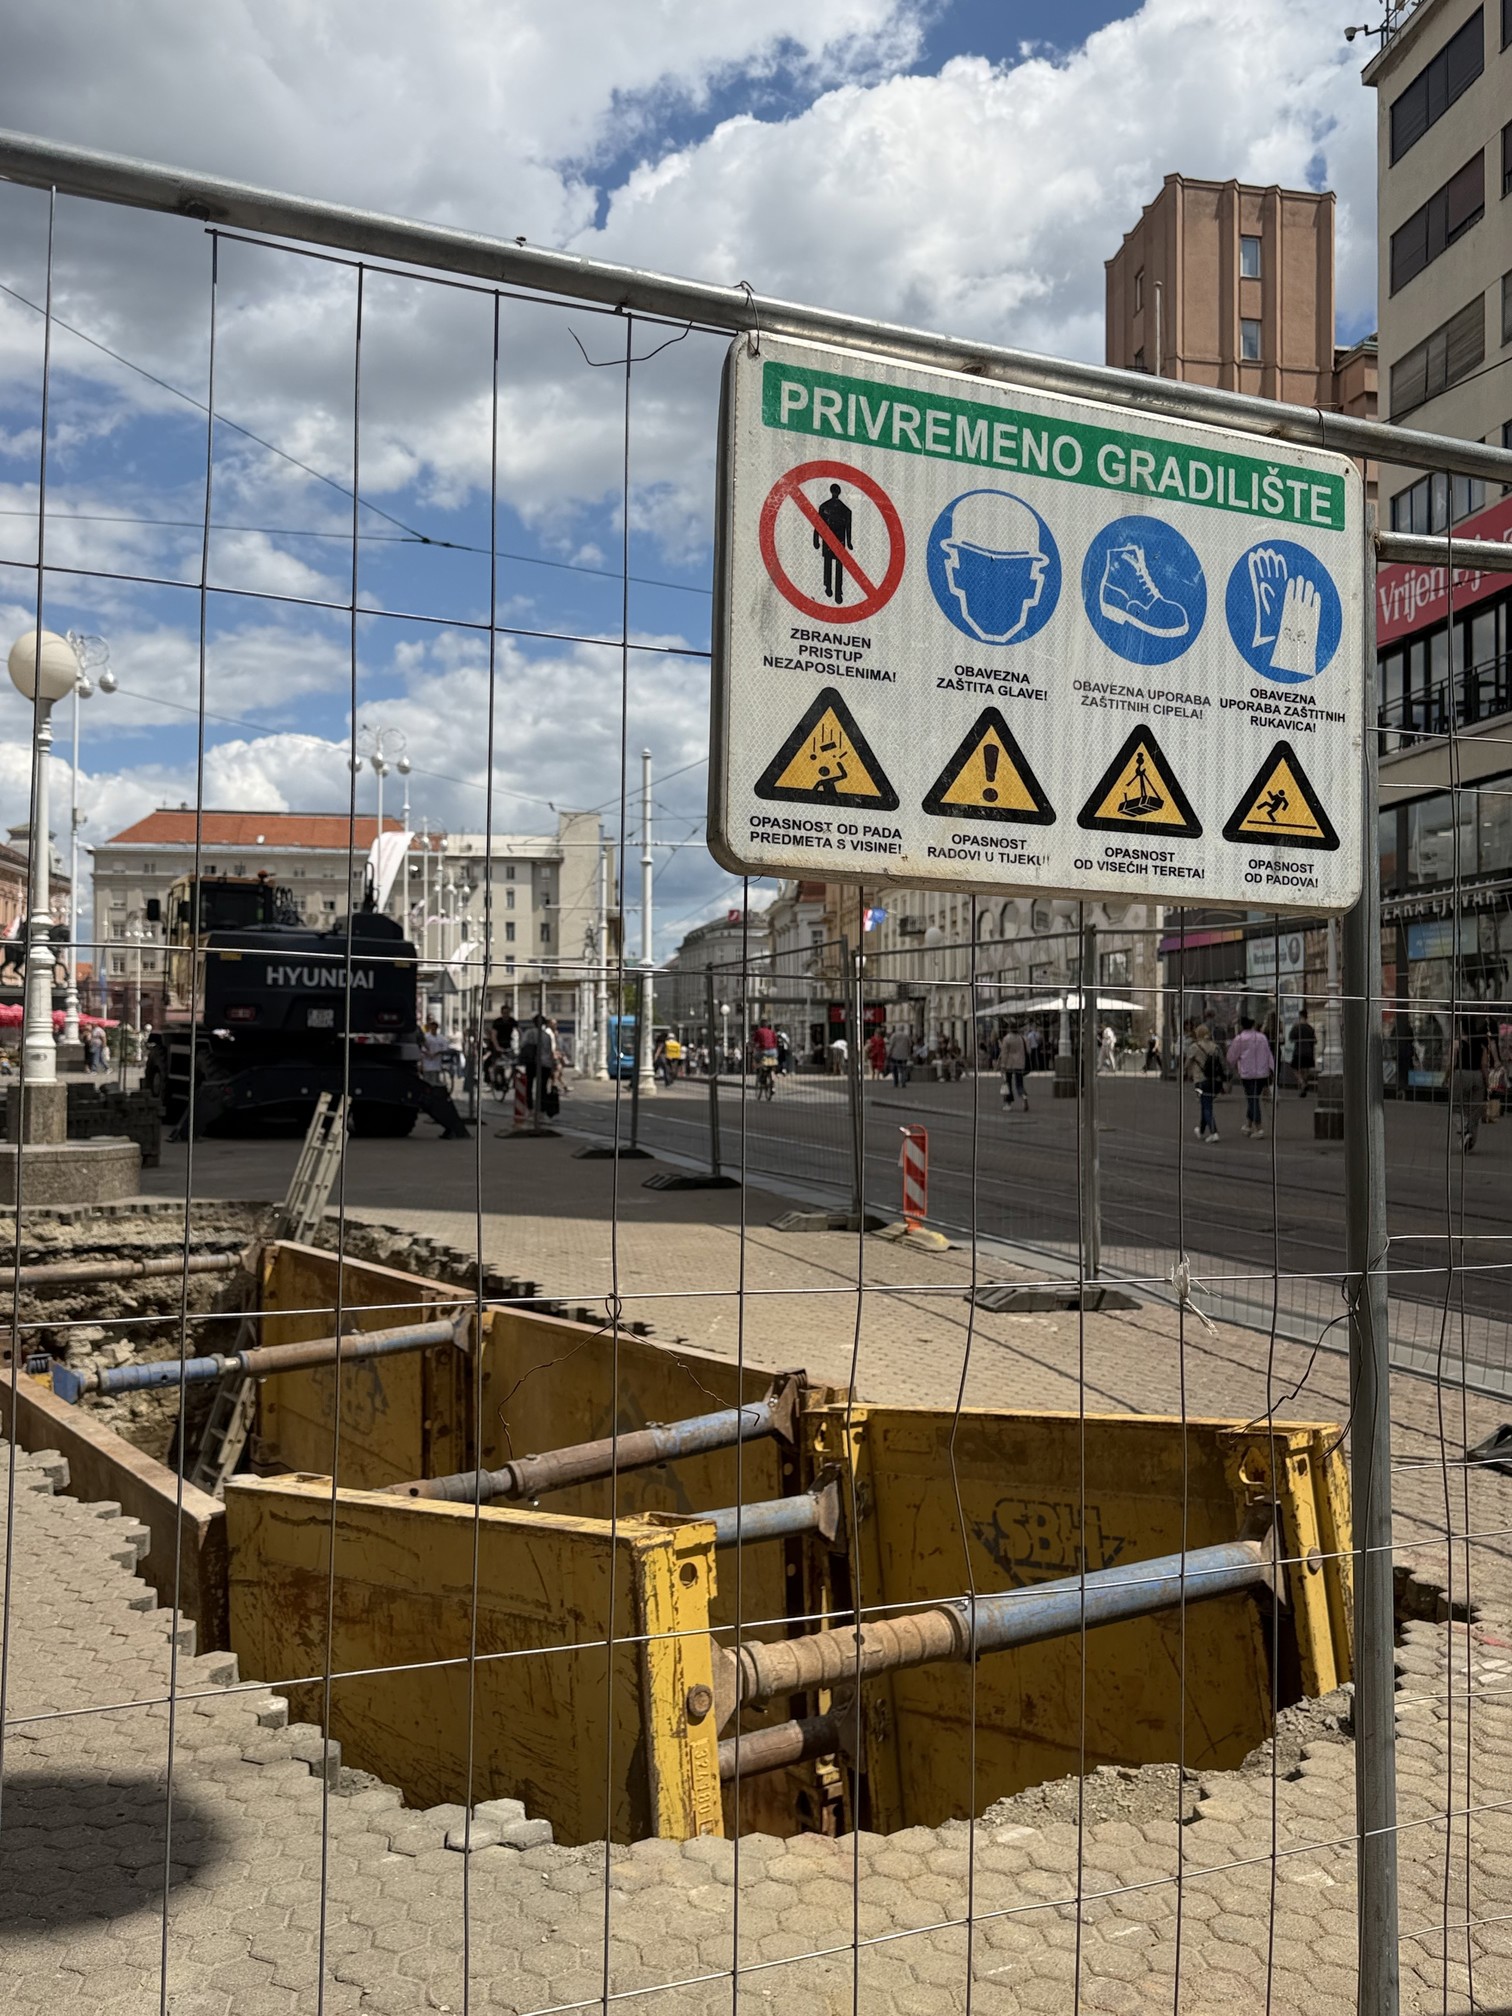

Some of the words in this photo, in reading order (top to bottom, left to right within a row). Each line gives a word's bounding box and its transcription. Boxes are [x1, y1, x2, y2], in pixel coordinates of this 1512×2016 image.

[779, 381, 1083, 477] PRIVREMENO
[1097, 443, 1332, 525] GRADILIŠTE
[790, 627, 871, 649] ZBRANJEN
[799, 644, 863, 663] PRISTUP
[763, 655, 896, 683] NEZAPOSLENIMA!
[954, 664, 1030, 684] OBAVEZNA
[936, 675, 994, 695] ZAŠTITA
[998, 684, 1048, 701] GLAVE!
[1073, 680, 1144, 699] OBAVEZNA
[1147, 689, 1211, 707] UPORABA
[1250, 688, 1316, 705] OBAVEZNA
[1081, 693, 1149, 714] ZAŠTITNIH
[1153, 704, 1203, 720] CIPELA!
[1220, 697, 1281, 715] UPORABA
[1284, 702, 1346, 723] ZAŠTITNIH
[1250, 715, 1316, 733] RUKAVICA!
[750, 815, 833, 833] OPASNOST
[837, 824, 859, 837] OD
[863, 826, 903, 840] PADA
[750, 831, 832, 849] PREDMETA
[836, 838, 846, 850] S
[850, 840, 902, 855] VISINE!
[952, 834, 1027, 851] OPASNOST
[927, 846, 980, 862] RADOVI
[985, 851, 994, 863] U
[1104, 847, 1175, 863] OPASNOST
[1073, 859, 1094, 870] OD
[1097, 860, 1148, 874] VISEĆIH
[1153, 865, 1205, 879] TERETA!
[1248, 859, 1314, 874] OPASNOST
[1244, 872, 1263, 884] OD
[1266, 874, 1318, 888] PADOVA!
[266, 965, 375, 990] HYUNDAI
